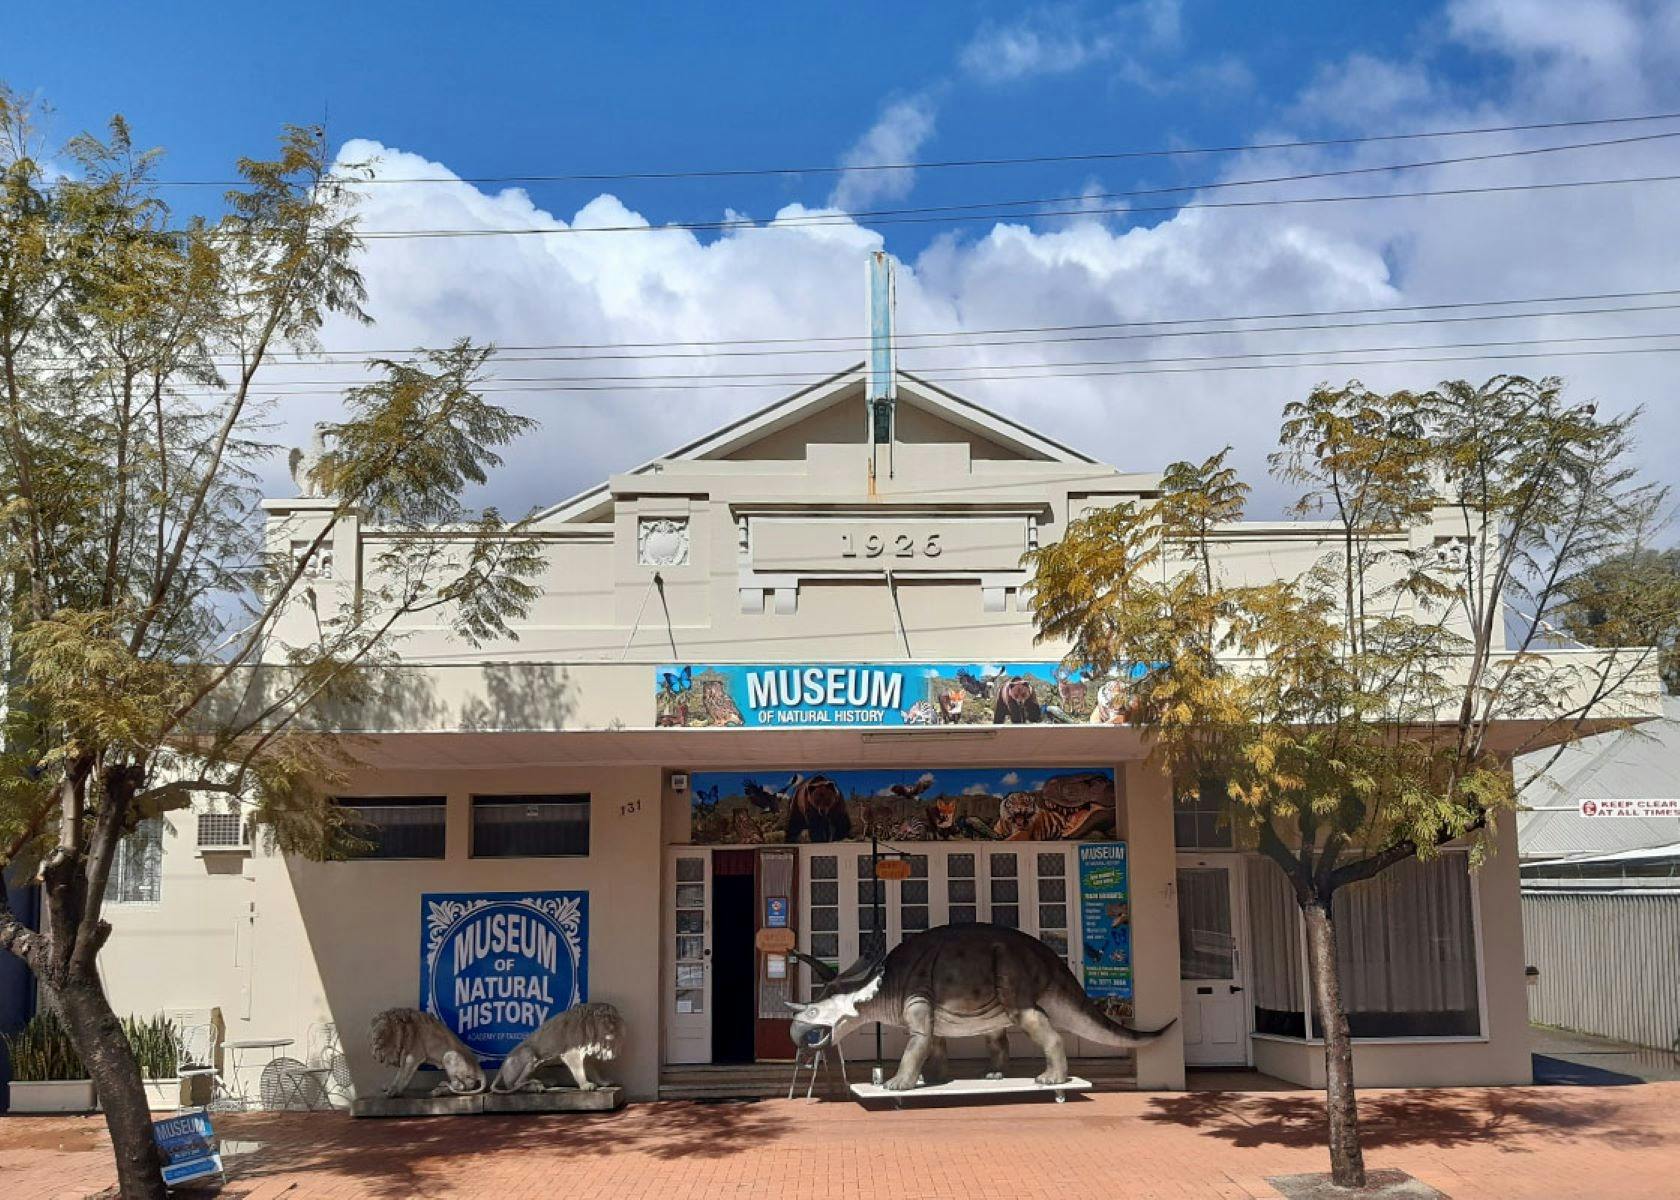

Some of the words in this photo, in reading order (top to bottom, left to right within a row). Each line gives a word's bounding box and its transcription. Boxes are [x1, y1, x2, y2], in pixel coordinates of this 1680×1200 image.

[842, 533, 942, 558] 1926
[746, 668, 903, 709] MUSEUM
[758, 710, 774, 723] OF
[777, 710, 832, 723] NATURAL
[834, 710, 885, 722] HISTORY
[621, 799, 641, 816] 131
[1080, 846, 1124, 861] MUSEUM
[453, 914, 557, 976] MUSEUM
[494, 959, 516, 972] OF
[455, 975, 554, 1007] NATURAL
[458, 1001, 549, 1034] HISTORY
[154, 1117, 206, 1141] MUSEUM
